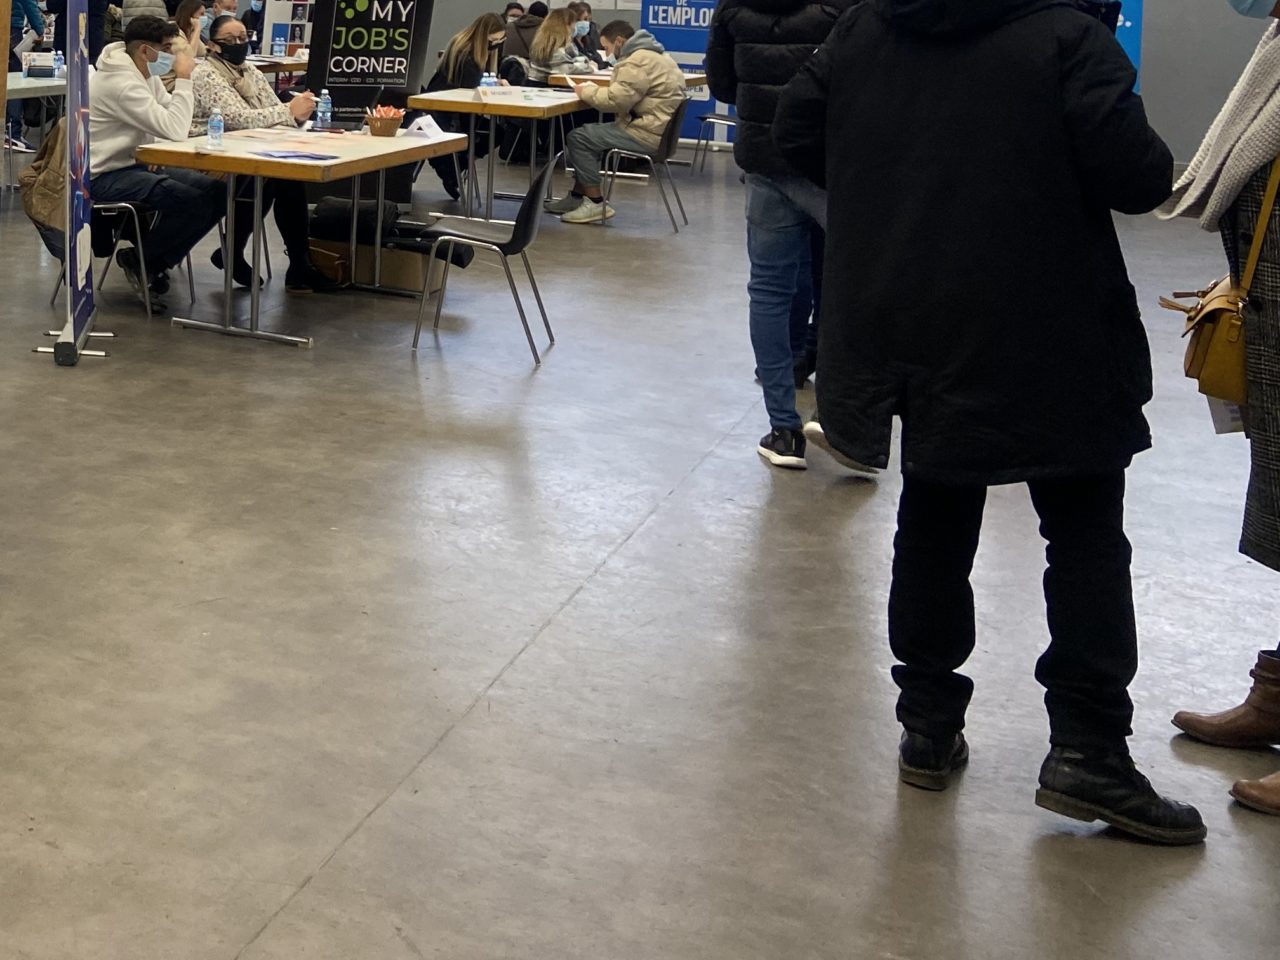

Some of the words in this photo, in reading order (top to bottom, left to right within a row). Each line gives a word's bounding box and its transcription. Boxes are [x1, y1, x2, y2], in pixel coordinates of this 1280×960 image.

[372, 0, 414, 22] MY
[332, 26, 409, 51] JOB'S
[330, 56, 407, 74] CORNER
